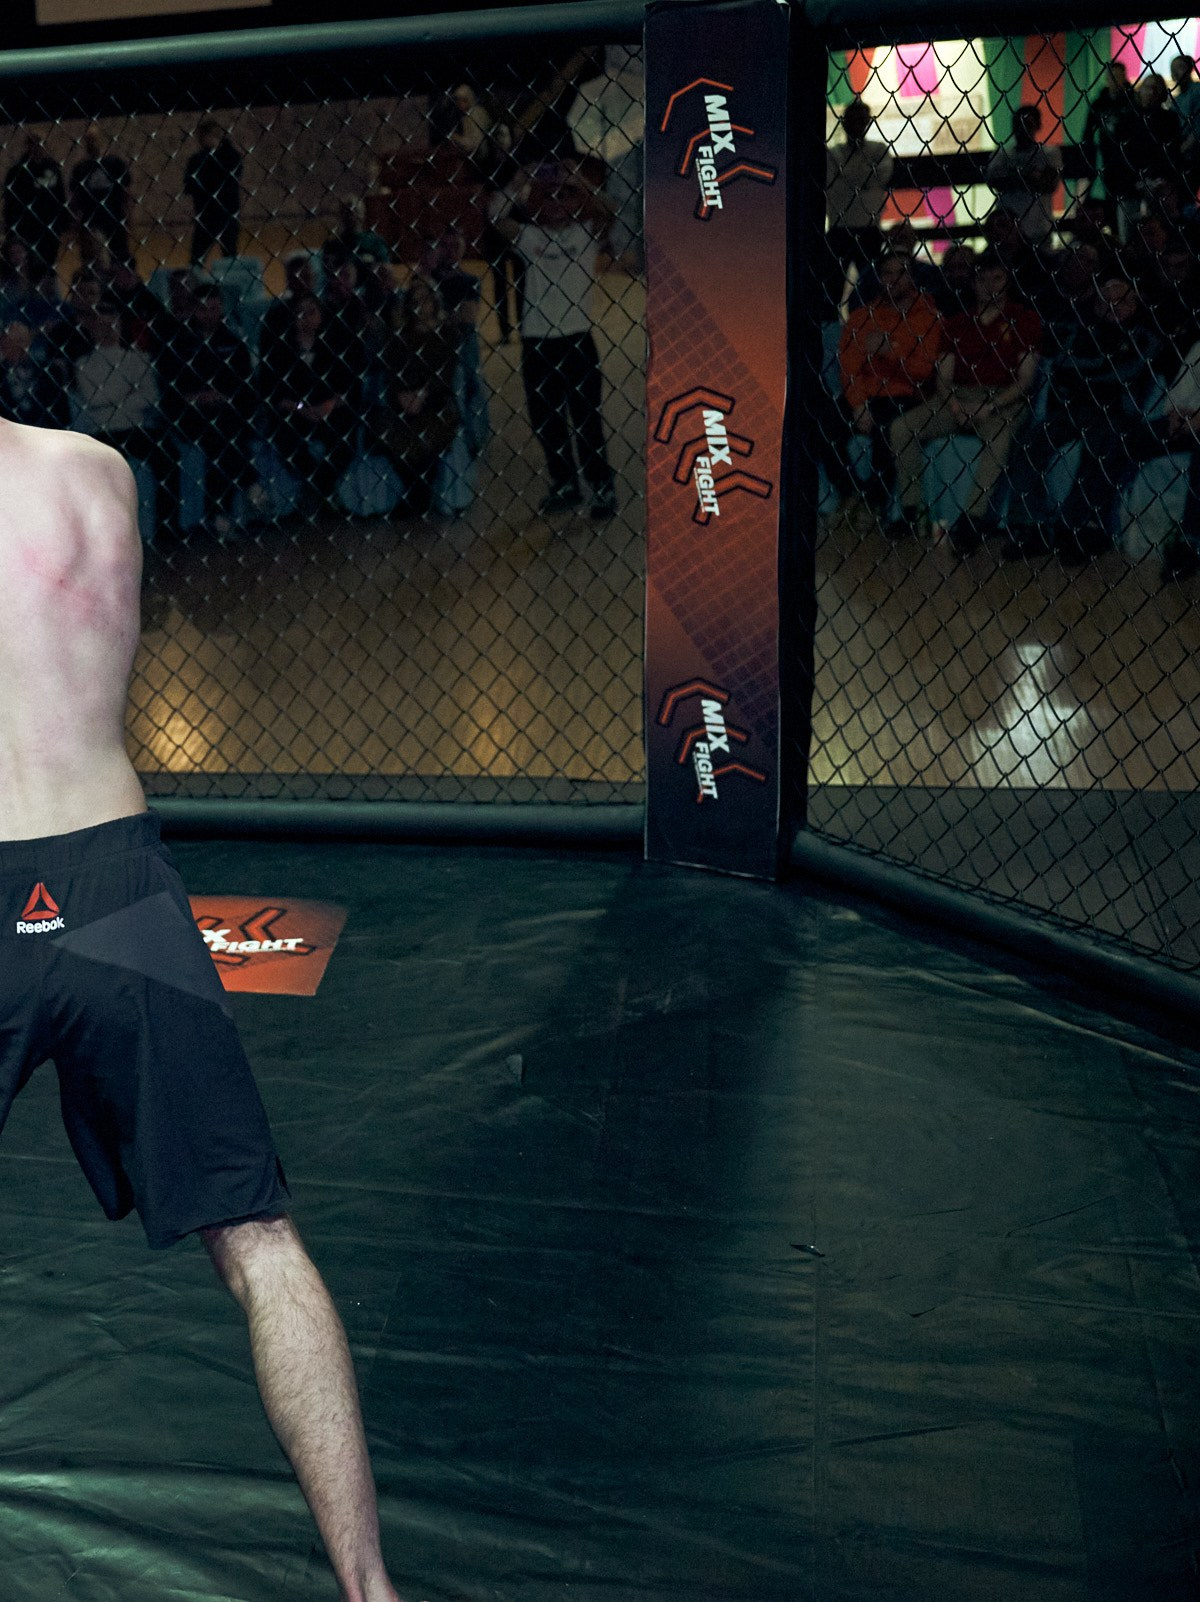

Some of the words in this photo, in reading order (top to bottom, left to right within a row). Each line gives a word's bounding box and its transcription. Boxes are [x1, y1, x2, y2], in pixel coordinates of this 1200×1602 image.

[704, 94, 736, 155] MIX
[699, 145, 723, 209] FIGHT
[702, 410, 732, 465] MIX
[696, 456, 720, 516] FIGHT
[701, 699, 730, 753] MIX
[695, 742, 718, 799] FIGHT
[16, 916, 65, 934] Reebok
[210, 938, 304, 952] FIGHT
